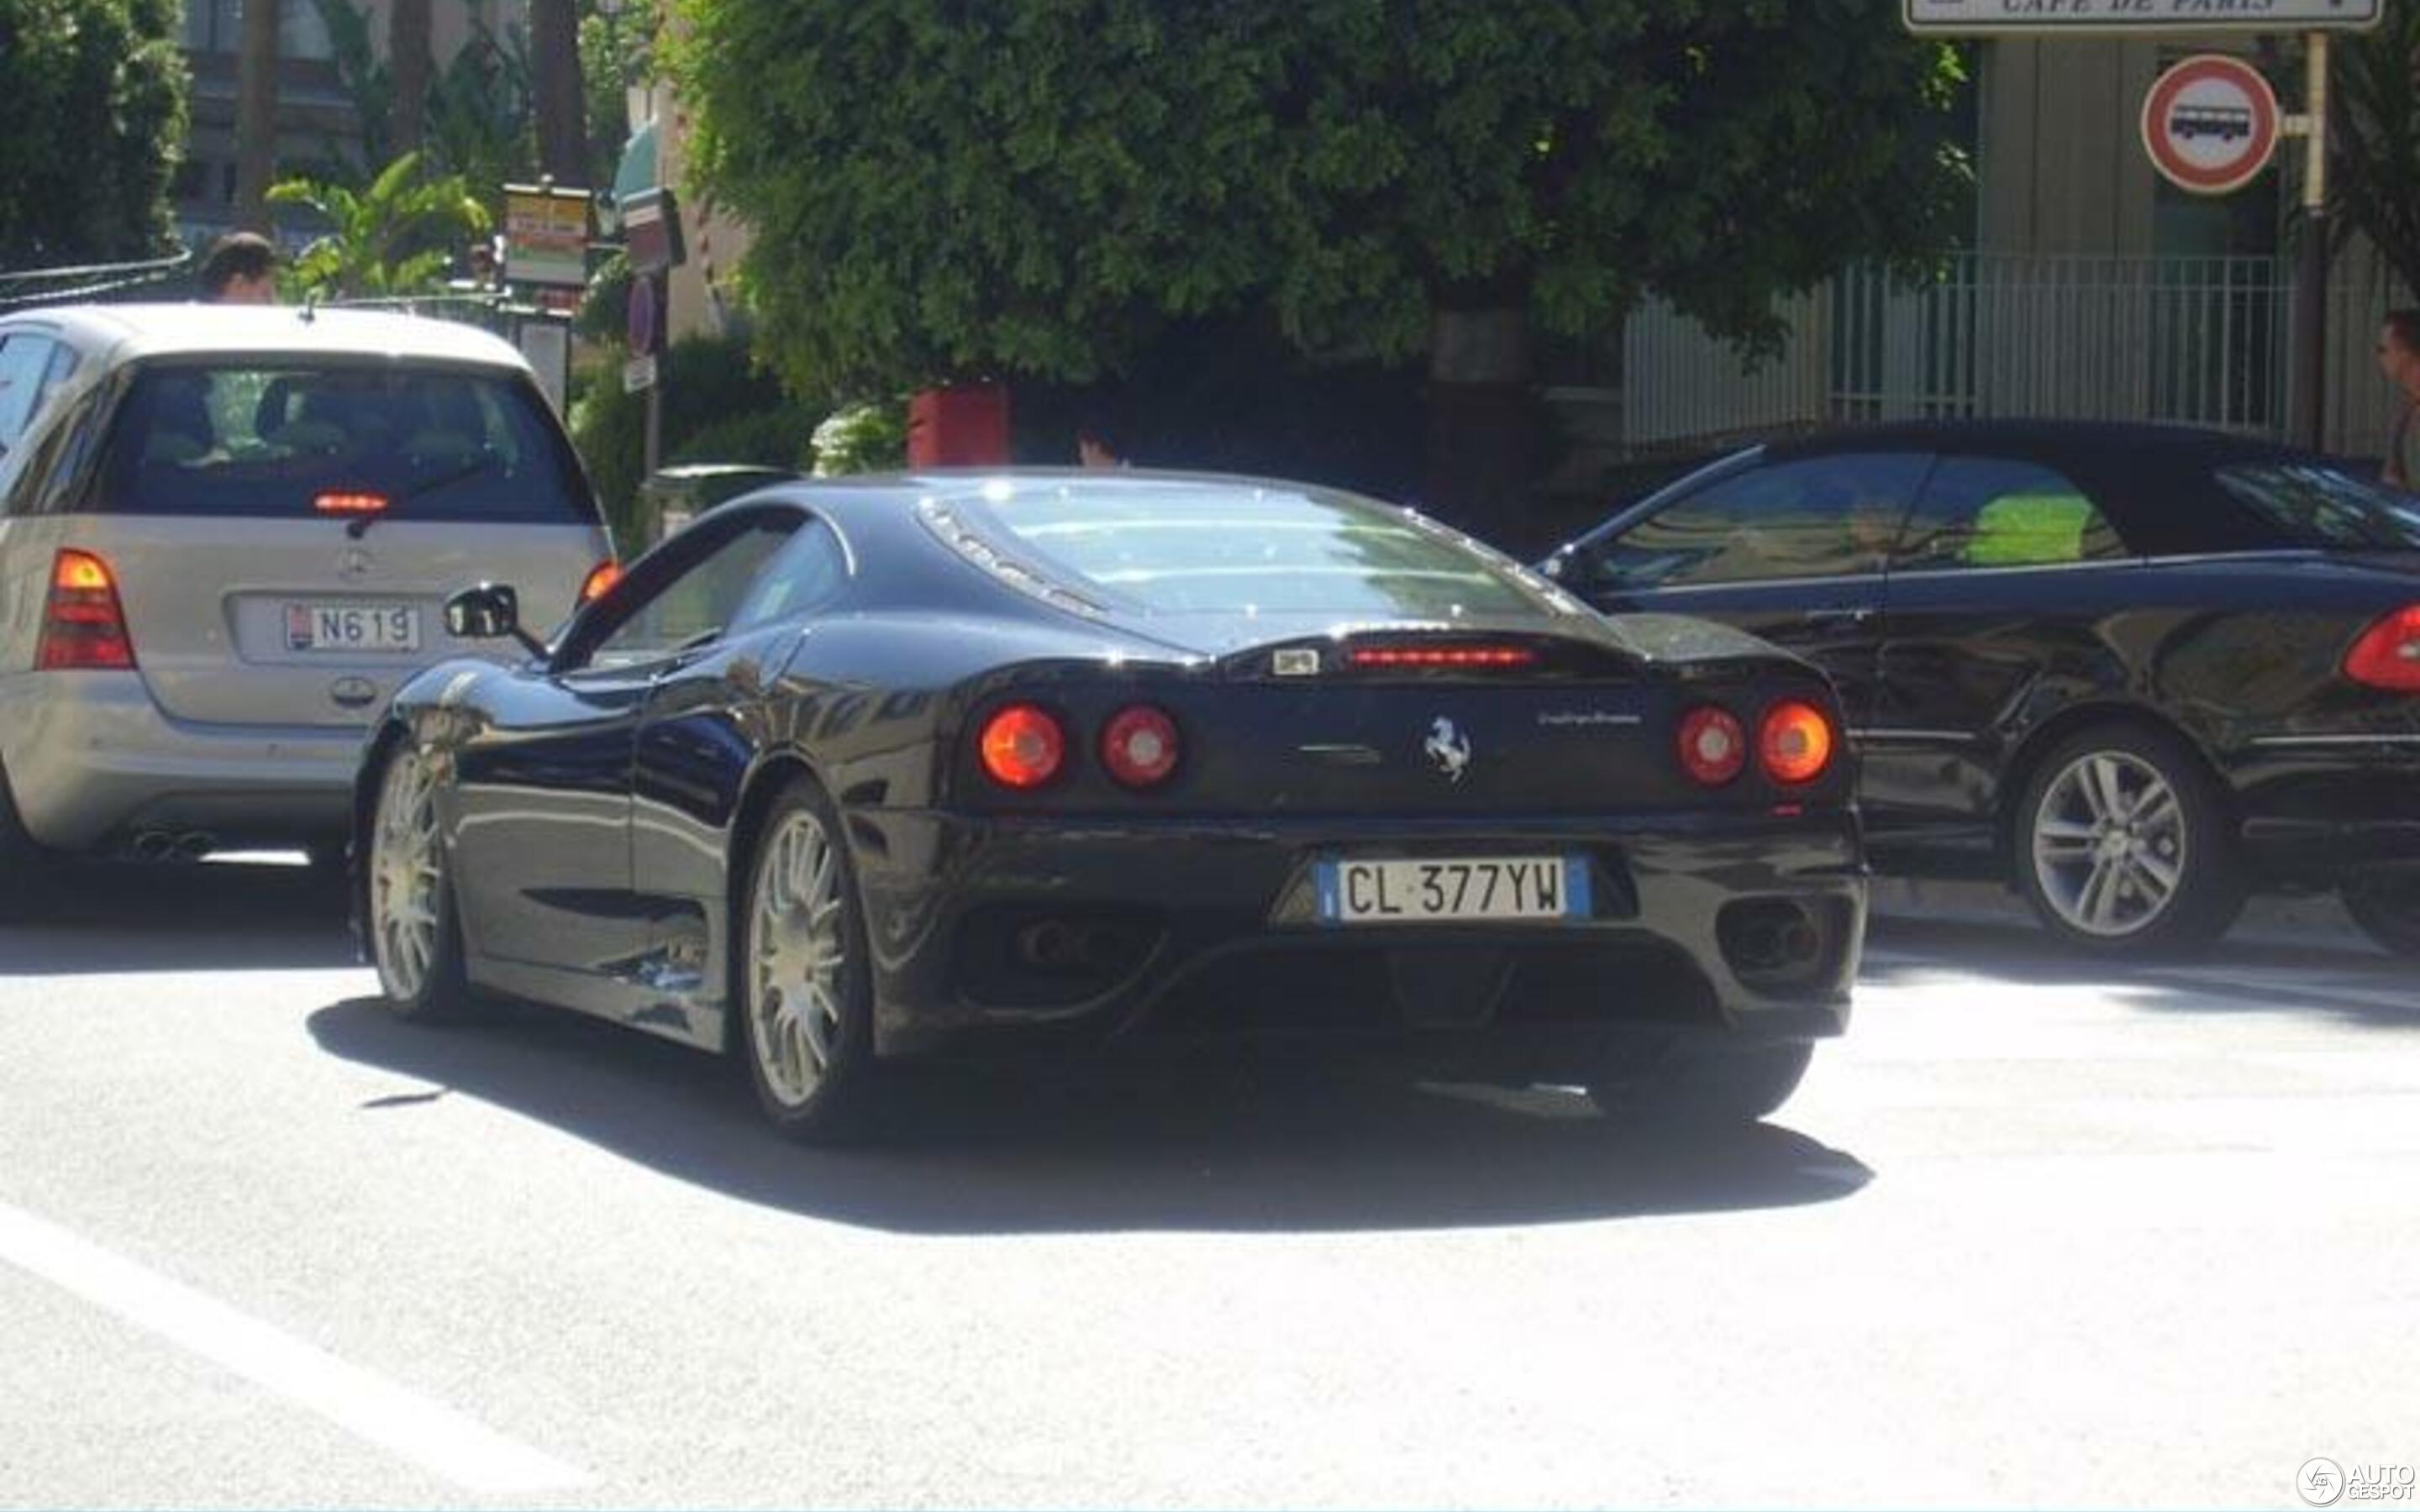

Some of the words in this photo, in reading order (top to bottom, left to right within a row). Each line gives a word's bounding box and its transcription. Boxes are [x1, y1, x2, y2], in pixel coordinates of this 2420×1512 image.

[321, 608, 409, 642] N619
[1348, 865, 1402, 914] CL
[1419, 864, 1557, 913] 377YW
